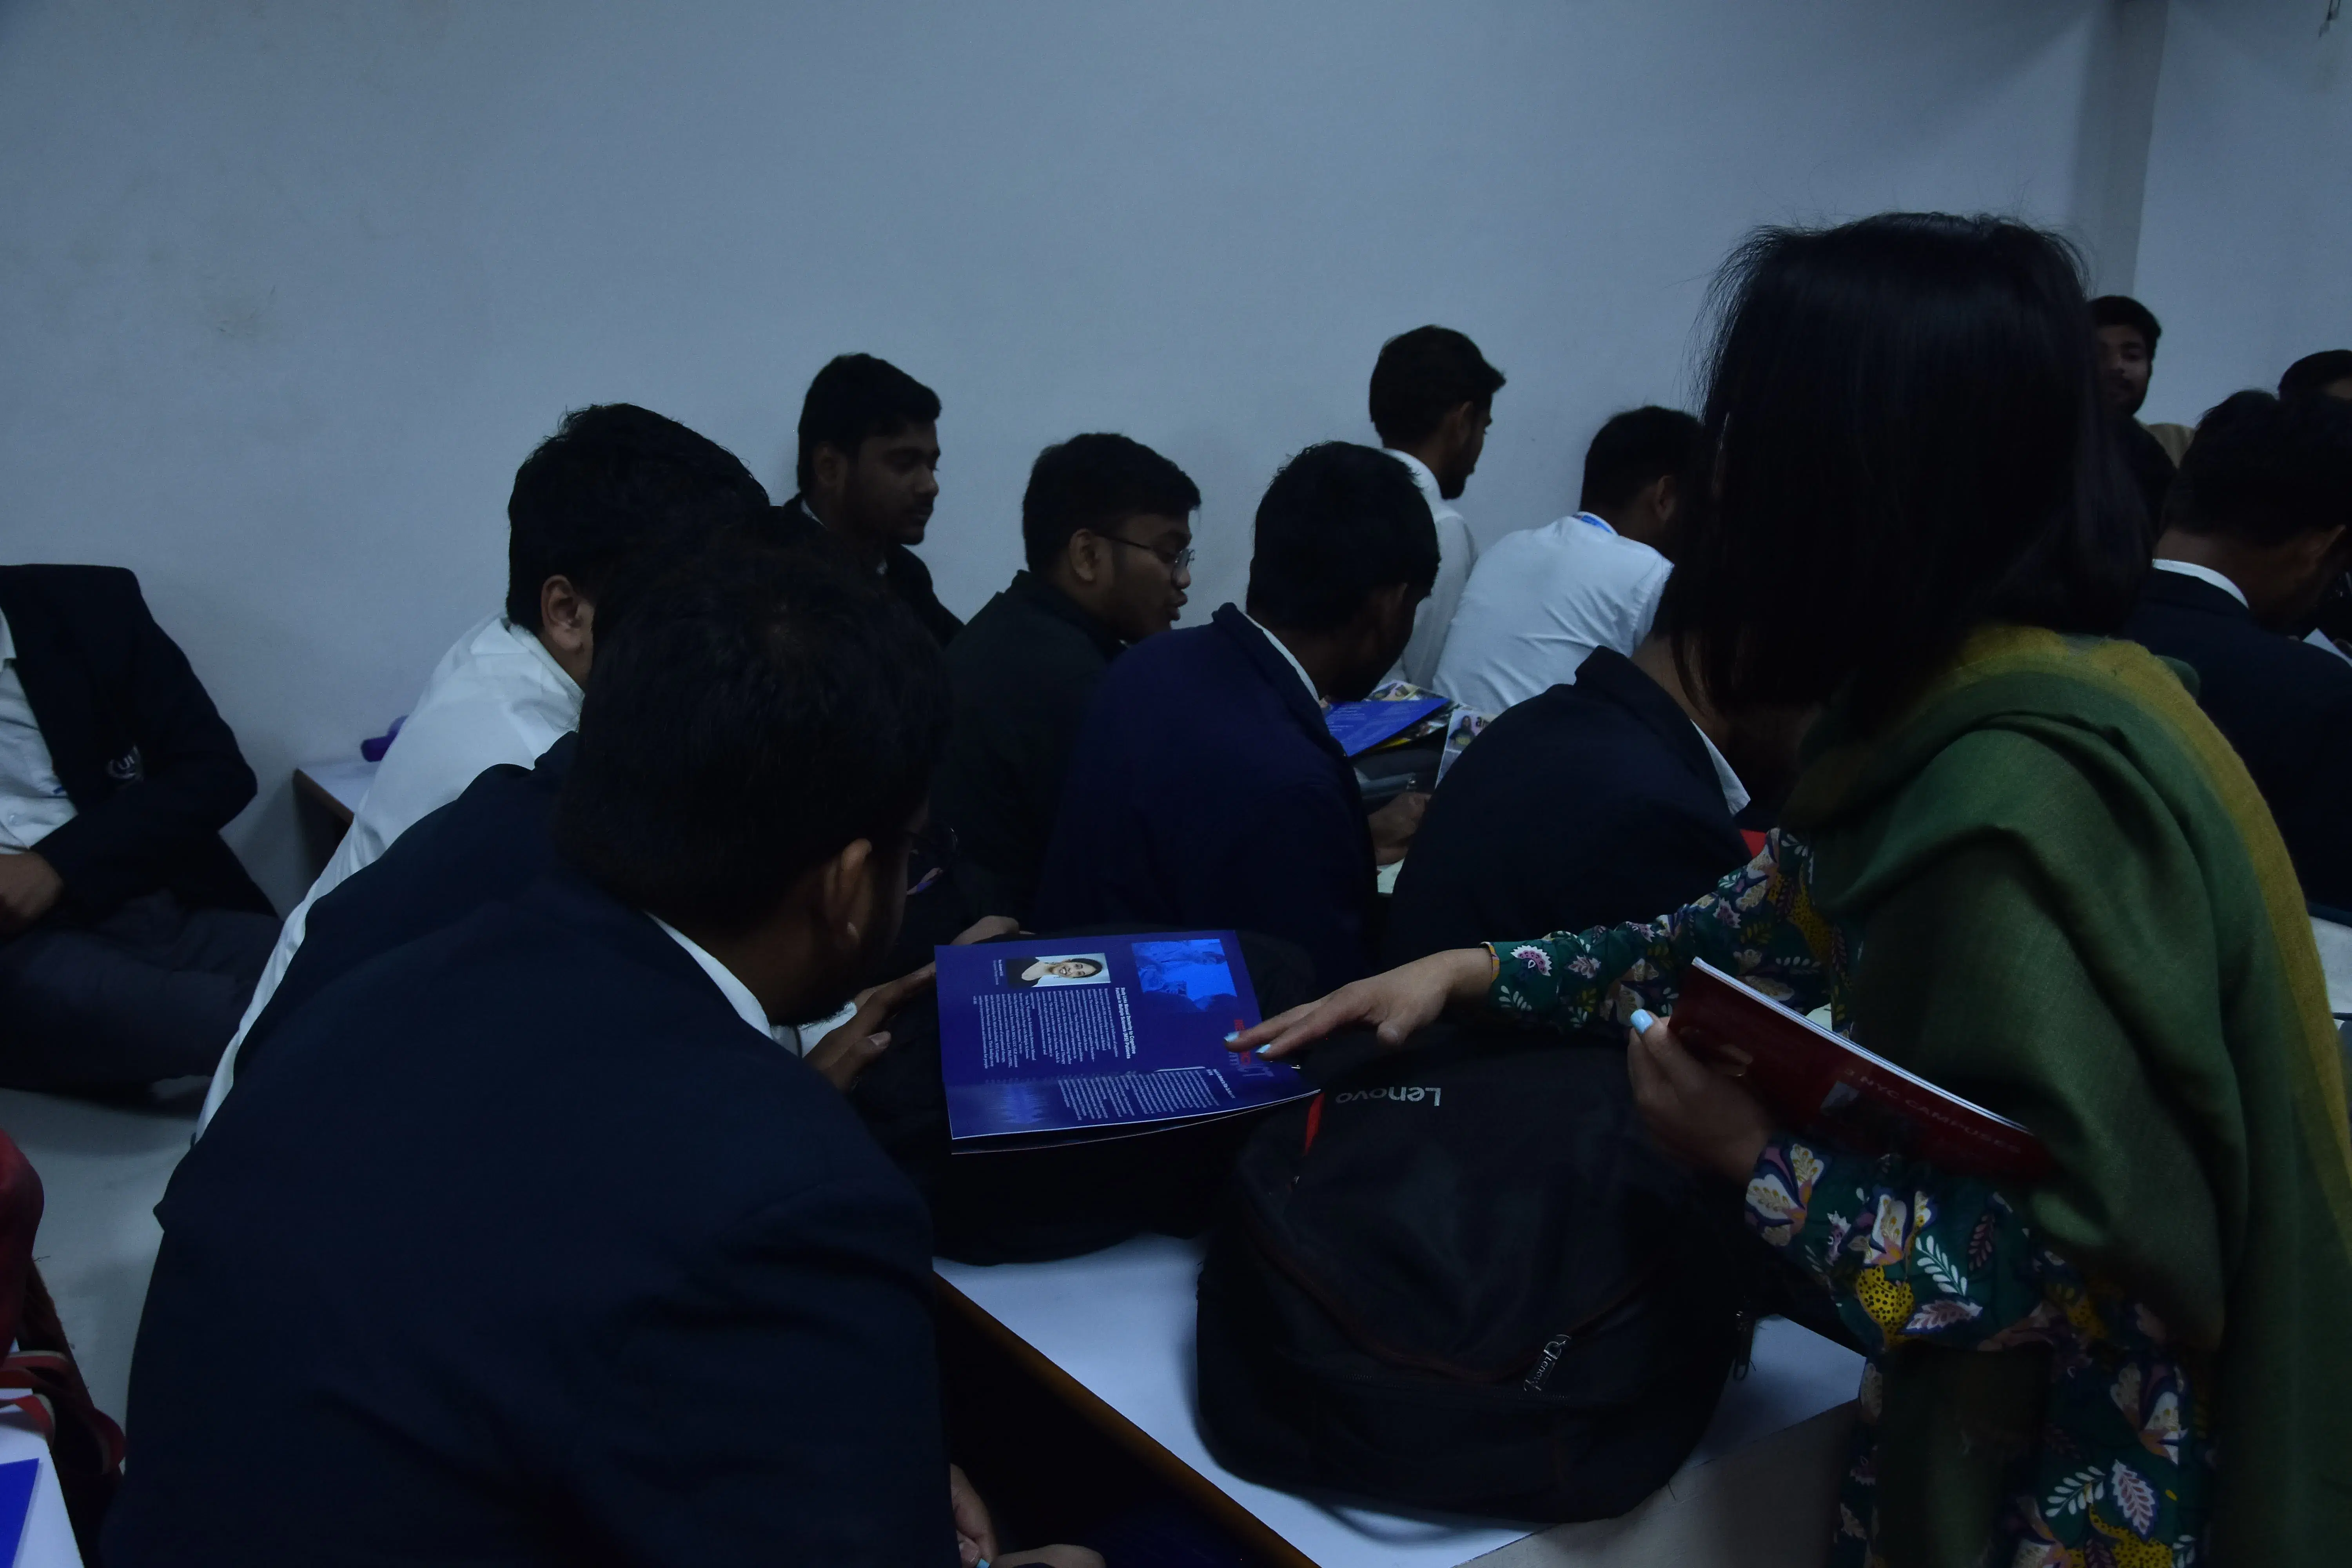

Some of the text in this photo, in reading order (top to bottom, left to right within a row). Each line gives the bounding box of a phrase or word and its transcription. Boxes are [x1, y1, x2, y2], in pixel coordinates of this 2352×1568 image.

[1336, 1086, 1441, 1107] Lenovo
[1860, 1076, 1900, 1099] NYC
[1532, 1356, 1553, 1384] Leno
